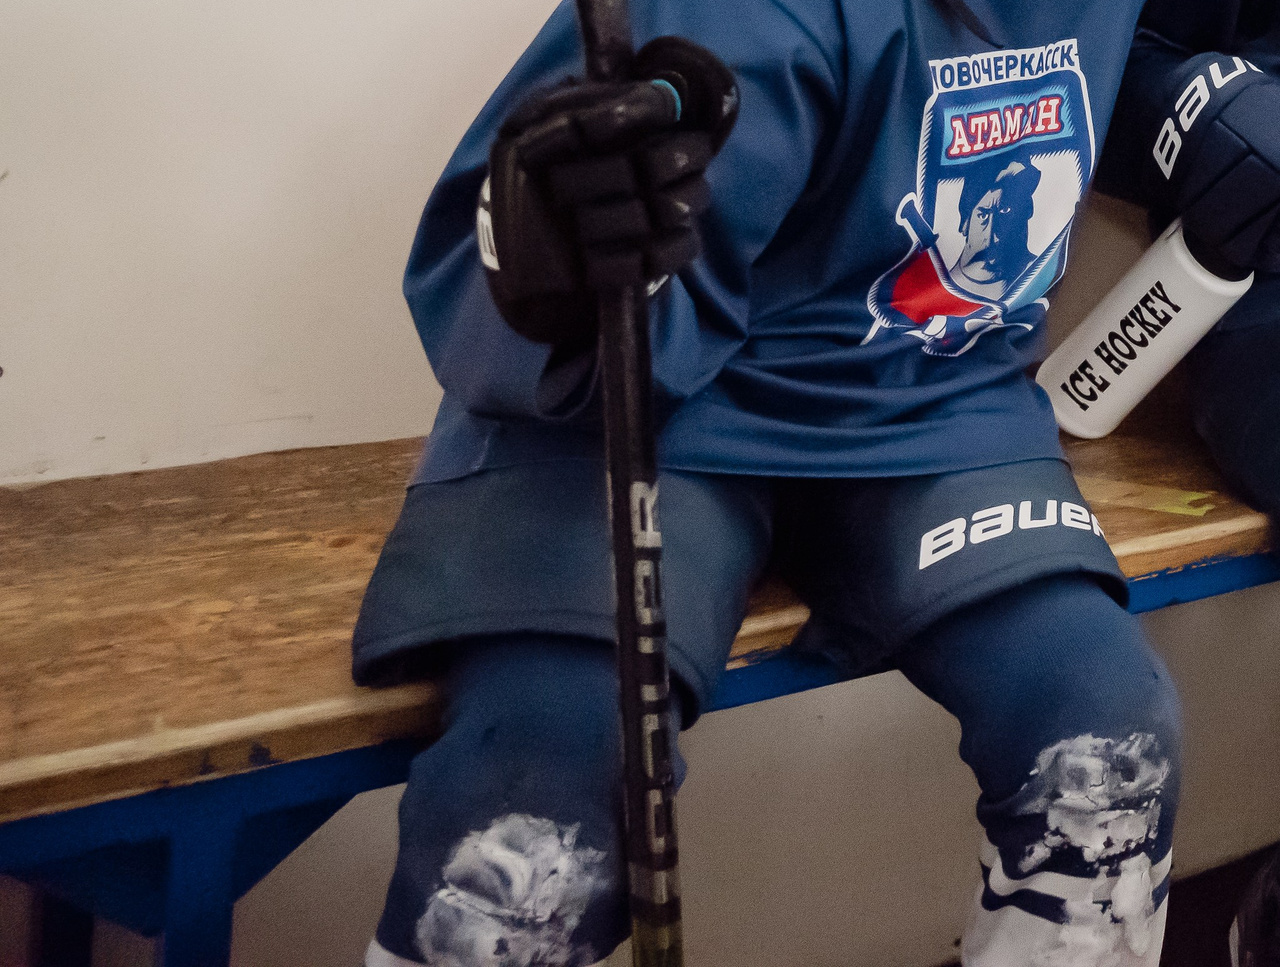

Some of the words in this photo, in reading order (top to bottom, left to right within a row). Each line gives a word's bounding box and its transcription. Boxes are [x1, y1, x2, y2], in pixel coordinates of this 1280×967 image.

[1152, 56, 1264, 180] BAU
[1060, 360, 1110, 412] ICE
[1093, 280, 1182, 376] HOCKEY
